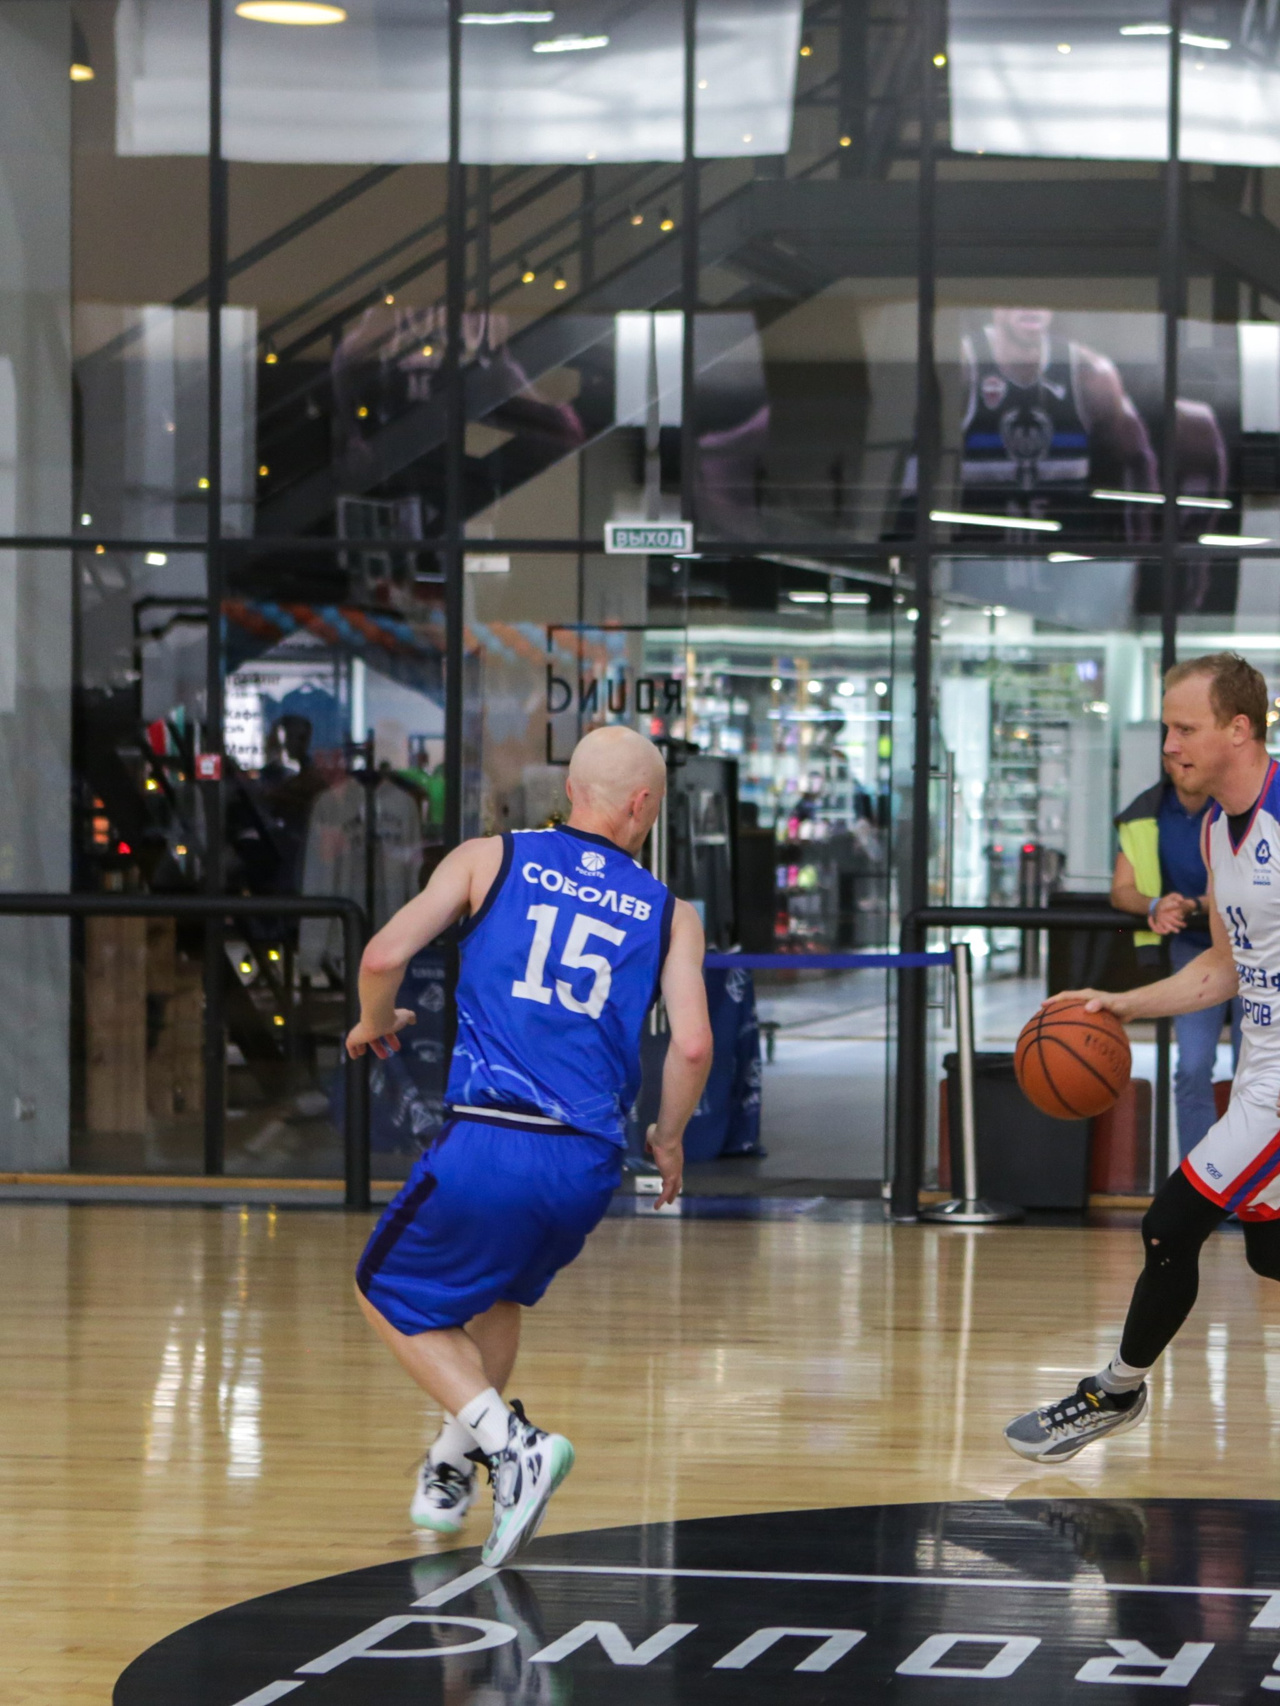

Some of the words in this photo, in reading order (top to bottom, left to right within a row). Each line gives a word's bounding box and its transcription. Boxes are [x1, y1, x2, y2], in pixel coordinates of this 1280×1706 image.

[616, 531, 684, 548] ВЫХОД
[522, 861, 652, 921] СОБОЛЕВ
[1226, 905, 1253, 950] 11
[511, 903, 627, 1020] 15
[1240, 996, 1271, 1026] РОВ
